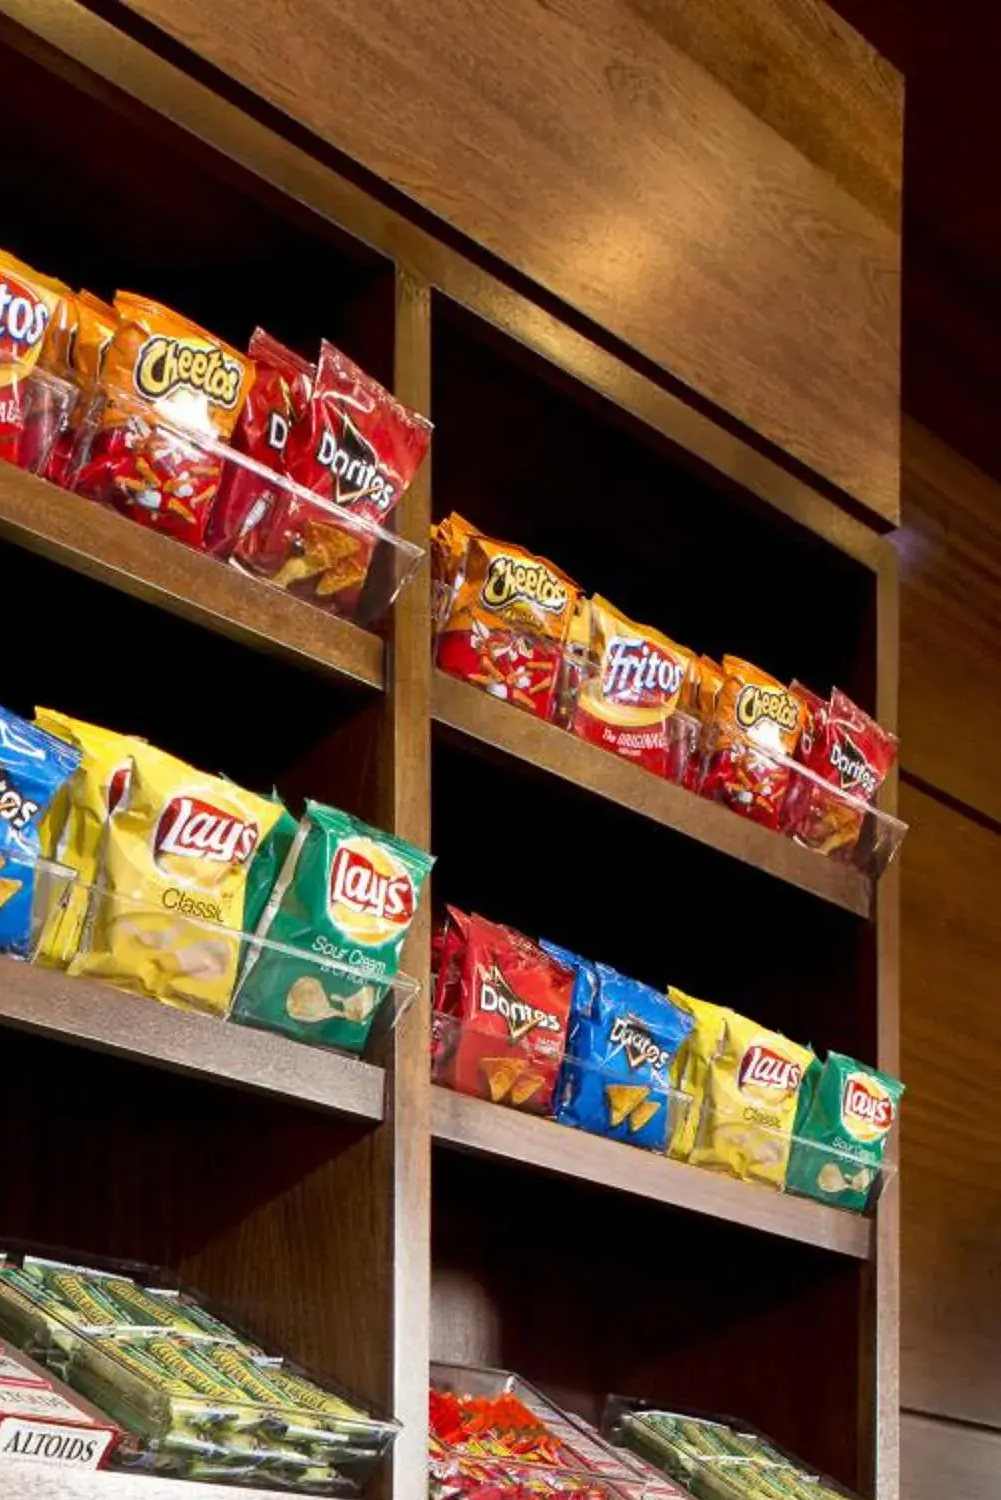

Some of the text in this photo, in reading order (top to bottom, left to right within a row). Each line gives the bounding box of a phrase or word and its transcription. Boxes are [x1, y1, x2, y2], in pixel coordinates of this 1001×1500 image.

[135, 336, 240, 405] Cheetos
[316, 430, 395, 510] Doritos
[484, 555, 568, 612] Cheetos
[602, 636, 684, 695] Fritos
[737, 685, 798, 731] Cheetos
[830, 743, 876, 793] Doritos
[479, 982, 561, 1032] Doritos
[3, 1430, 99, 1462] ALTOIDS
